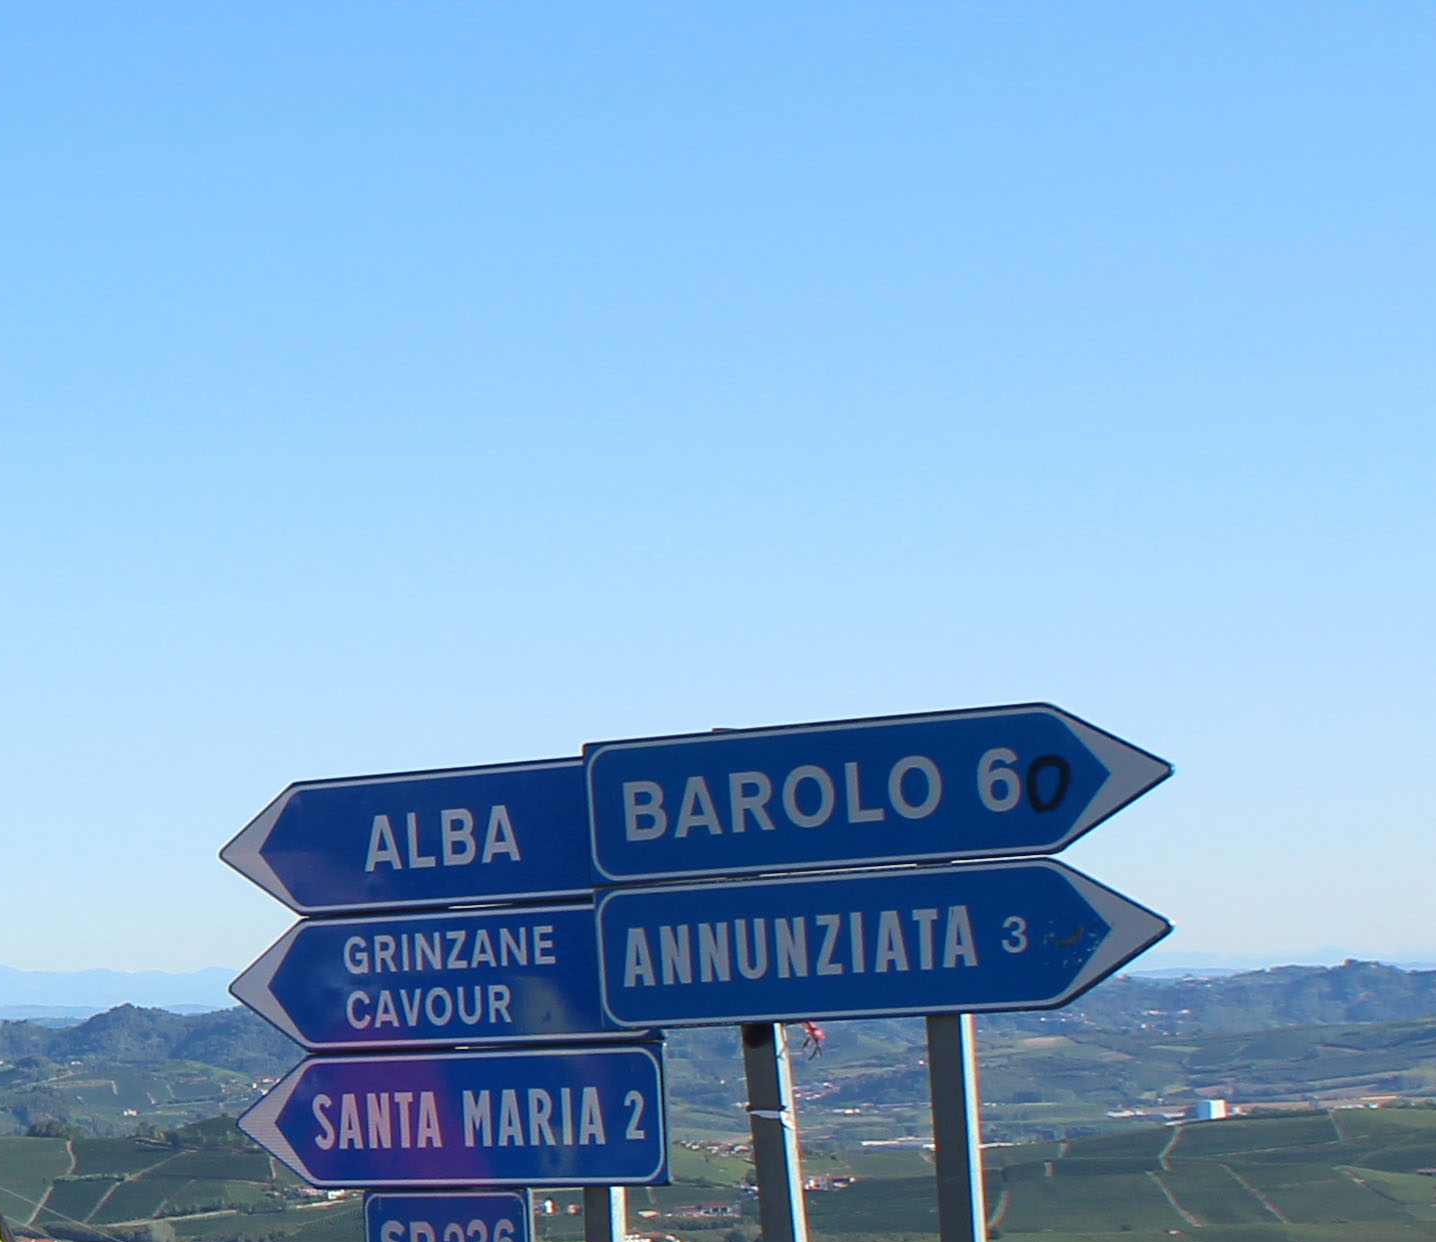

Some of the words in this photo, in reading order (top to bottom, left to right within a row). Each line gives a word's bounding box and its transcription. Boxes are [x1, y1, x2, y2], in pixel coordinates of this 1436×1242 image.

[622, 755, 943, 843] BAROLO
[365, 804, 522, 873] ALBA
[342, 925, 558, 976] GRINZANE
[623, 904, 979, 988] ANNUNZIATA
[1000, 914, 1029, 955] 3
[345, 984, 513, 1030] CAVOUR
[311, 1090, 444, 1151] SANTA
[462, 1085, 607, 1148] MARIA
[623, 1089, 647, 1142] 2
